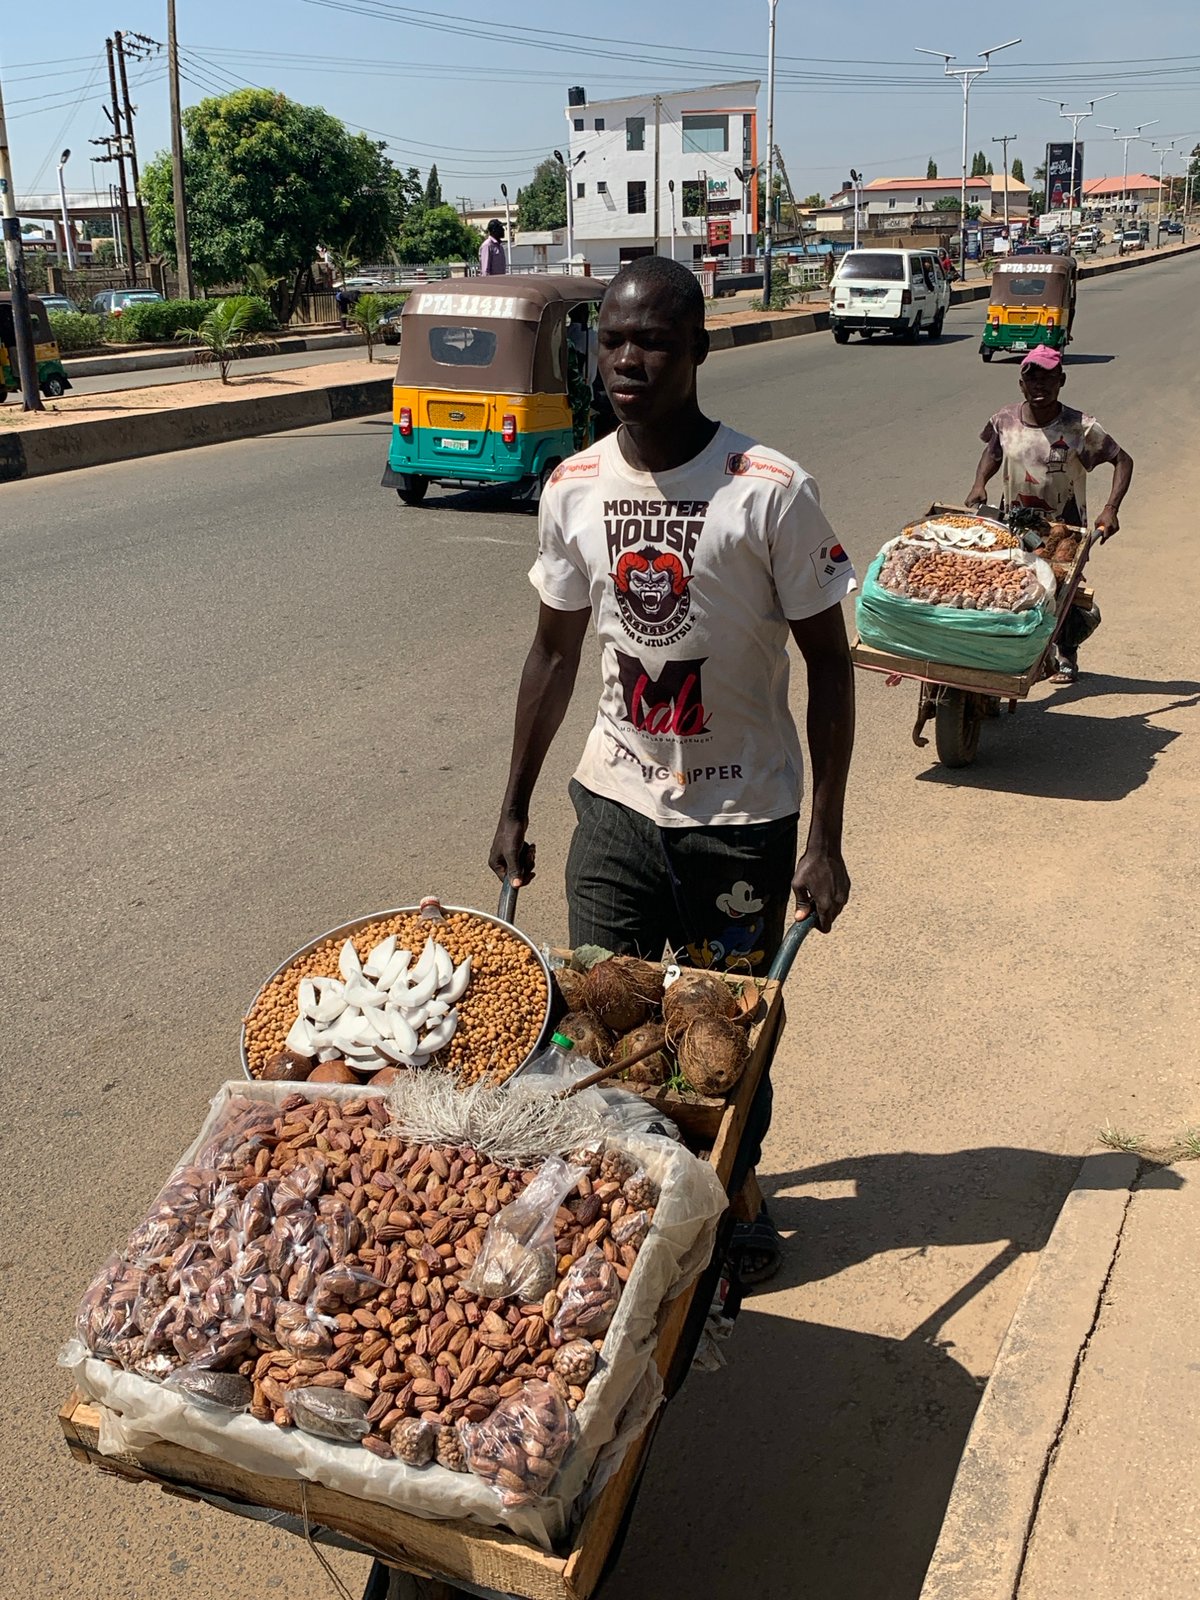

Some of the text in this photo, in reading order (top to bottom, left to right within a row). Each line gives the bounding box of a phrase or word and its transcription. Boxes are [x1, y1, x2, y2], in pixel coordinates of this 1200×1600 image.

[603, 500, 710, 517] MONSTER
[603, 519, 705, 574] HOUSE
[620, 618, 636, 640] MMA
[644, 623, 692, 647] JIUJITSU
